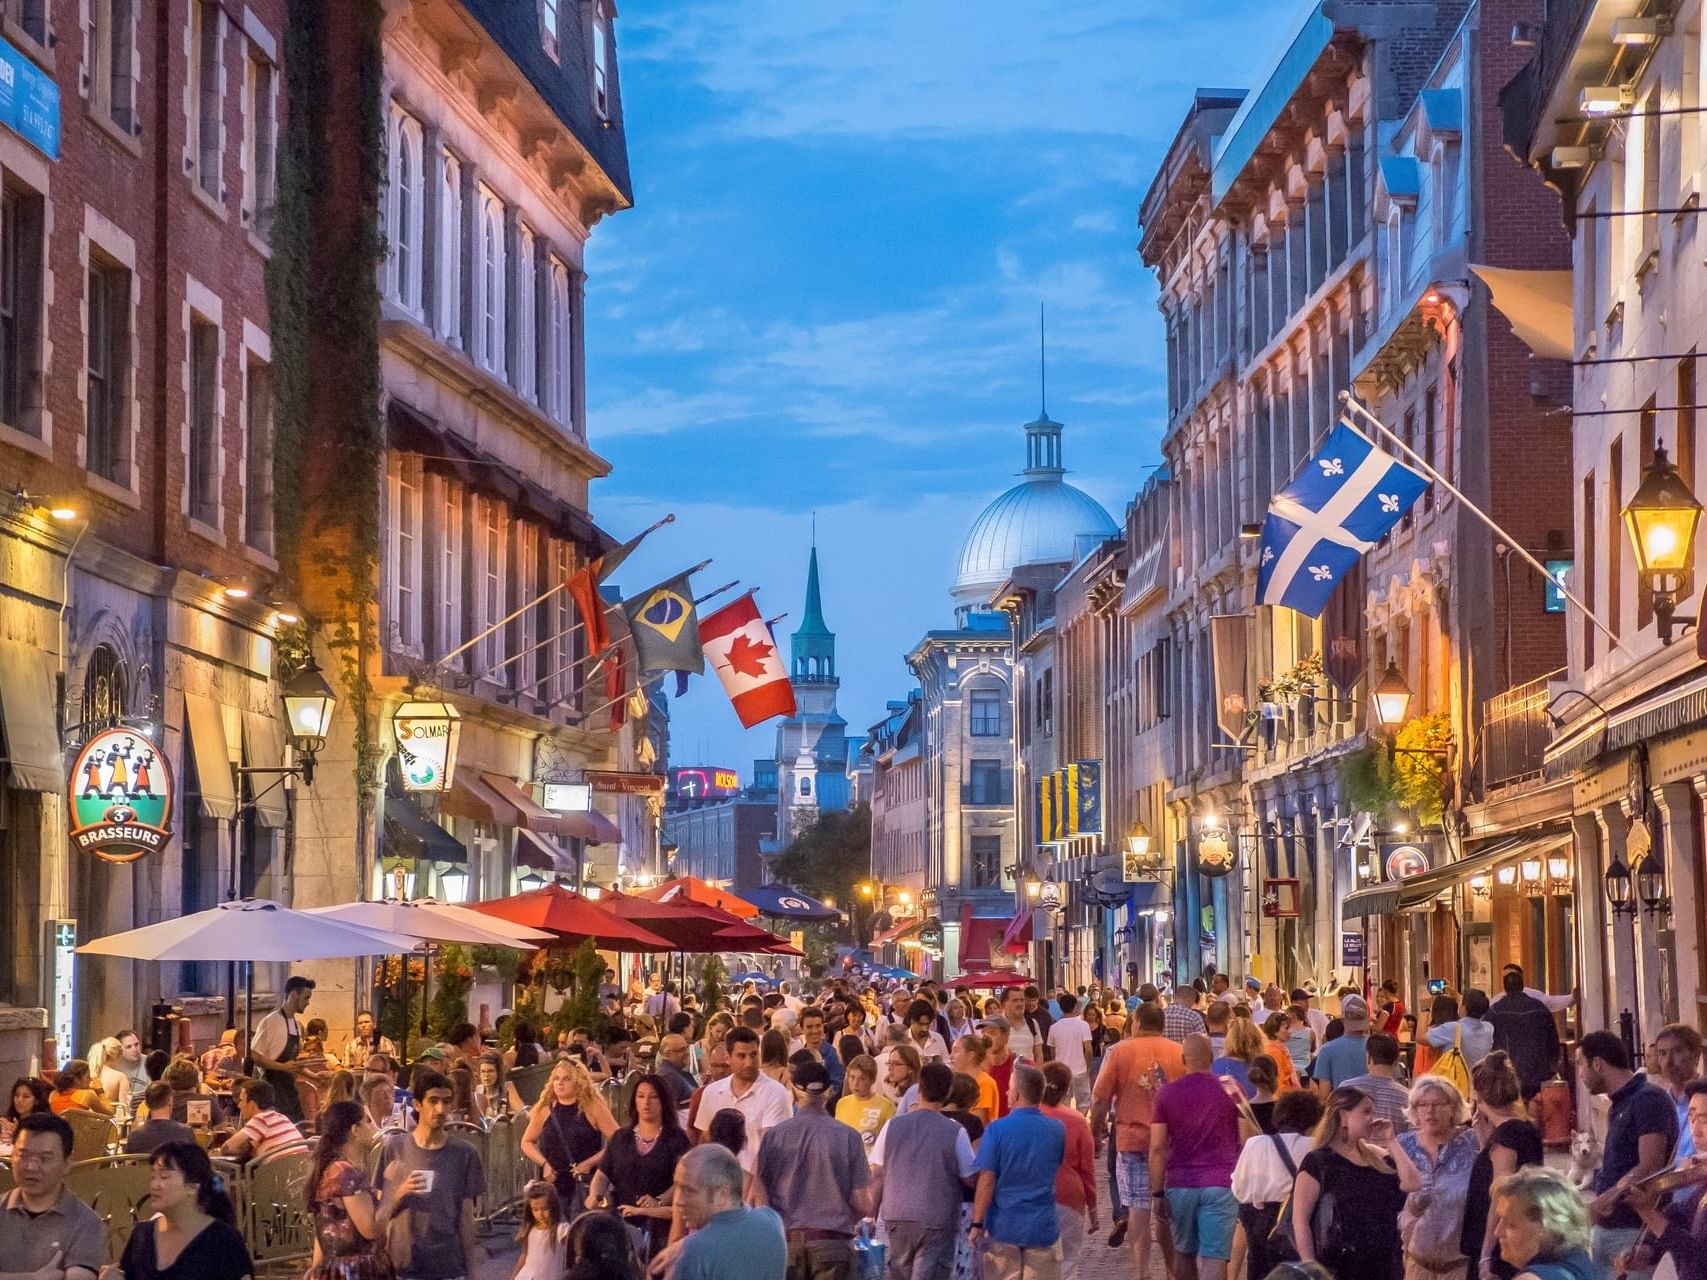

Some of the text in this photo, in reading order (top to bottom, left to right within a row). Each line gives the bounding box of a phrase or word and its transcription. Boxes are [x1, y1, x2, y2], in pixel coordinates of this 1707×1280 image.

[399, 719, 448, 740] SOLMAR
[114, 809, 125, 822] 3
[79, 827, 160, 847] BRASSEURS
